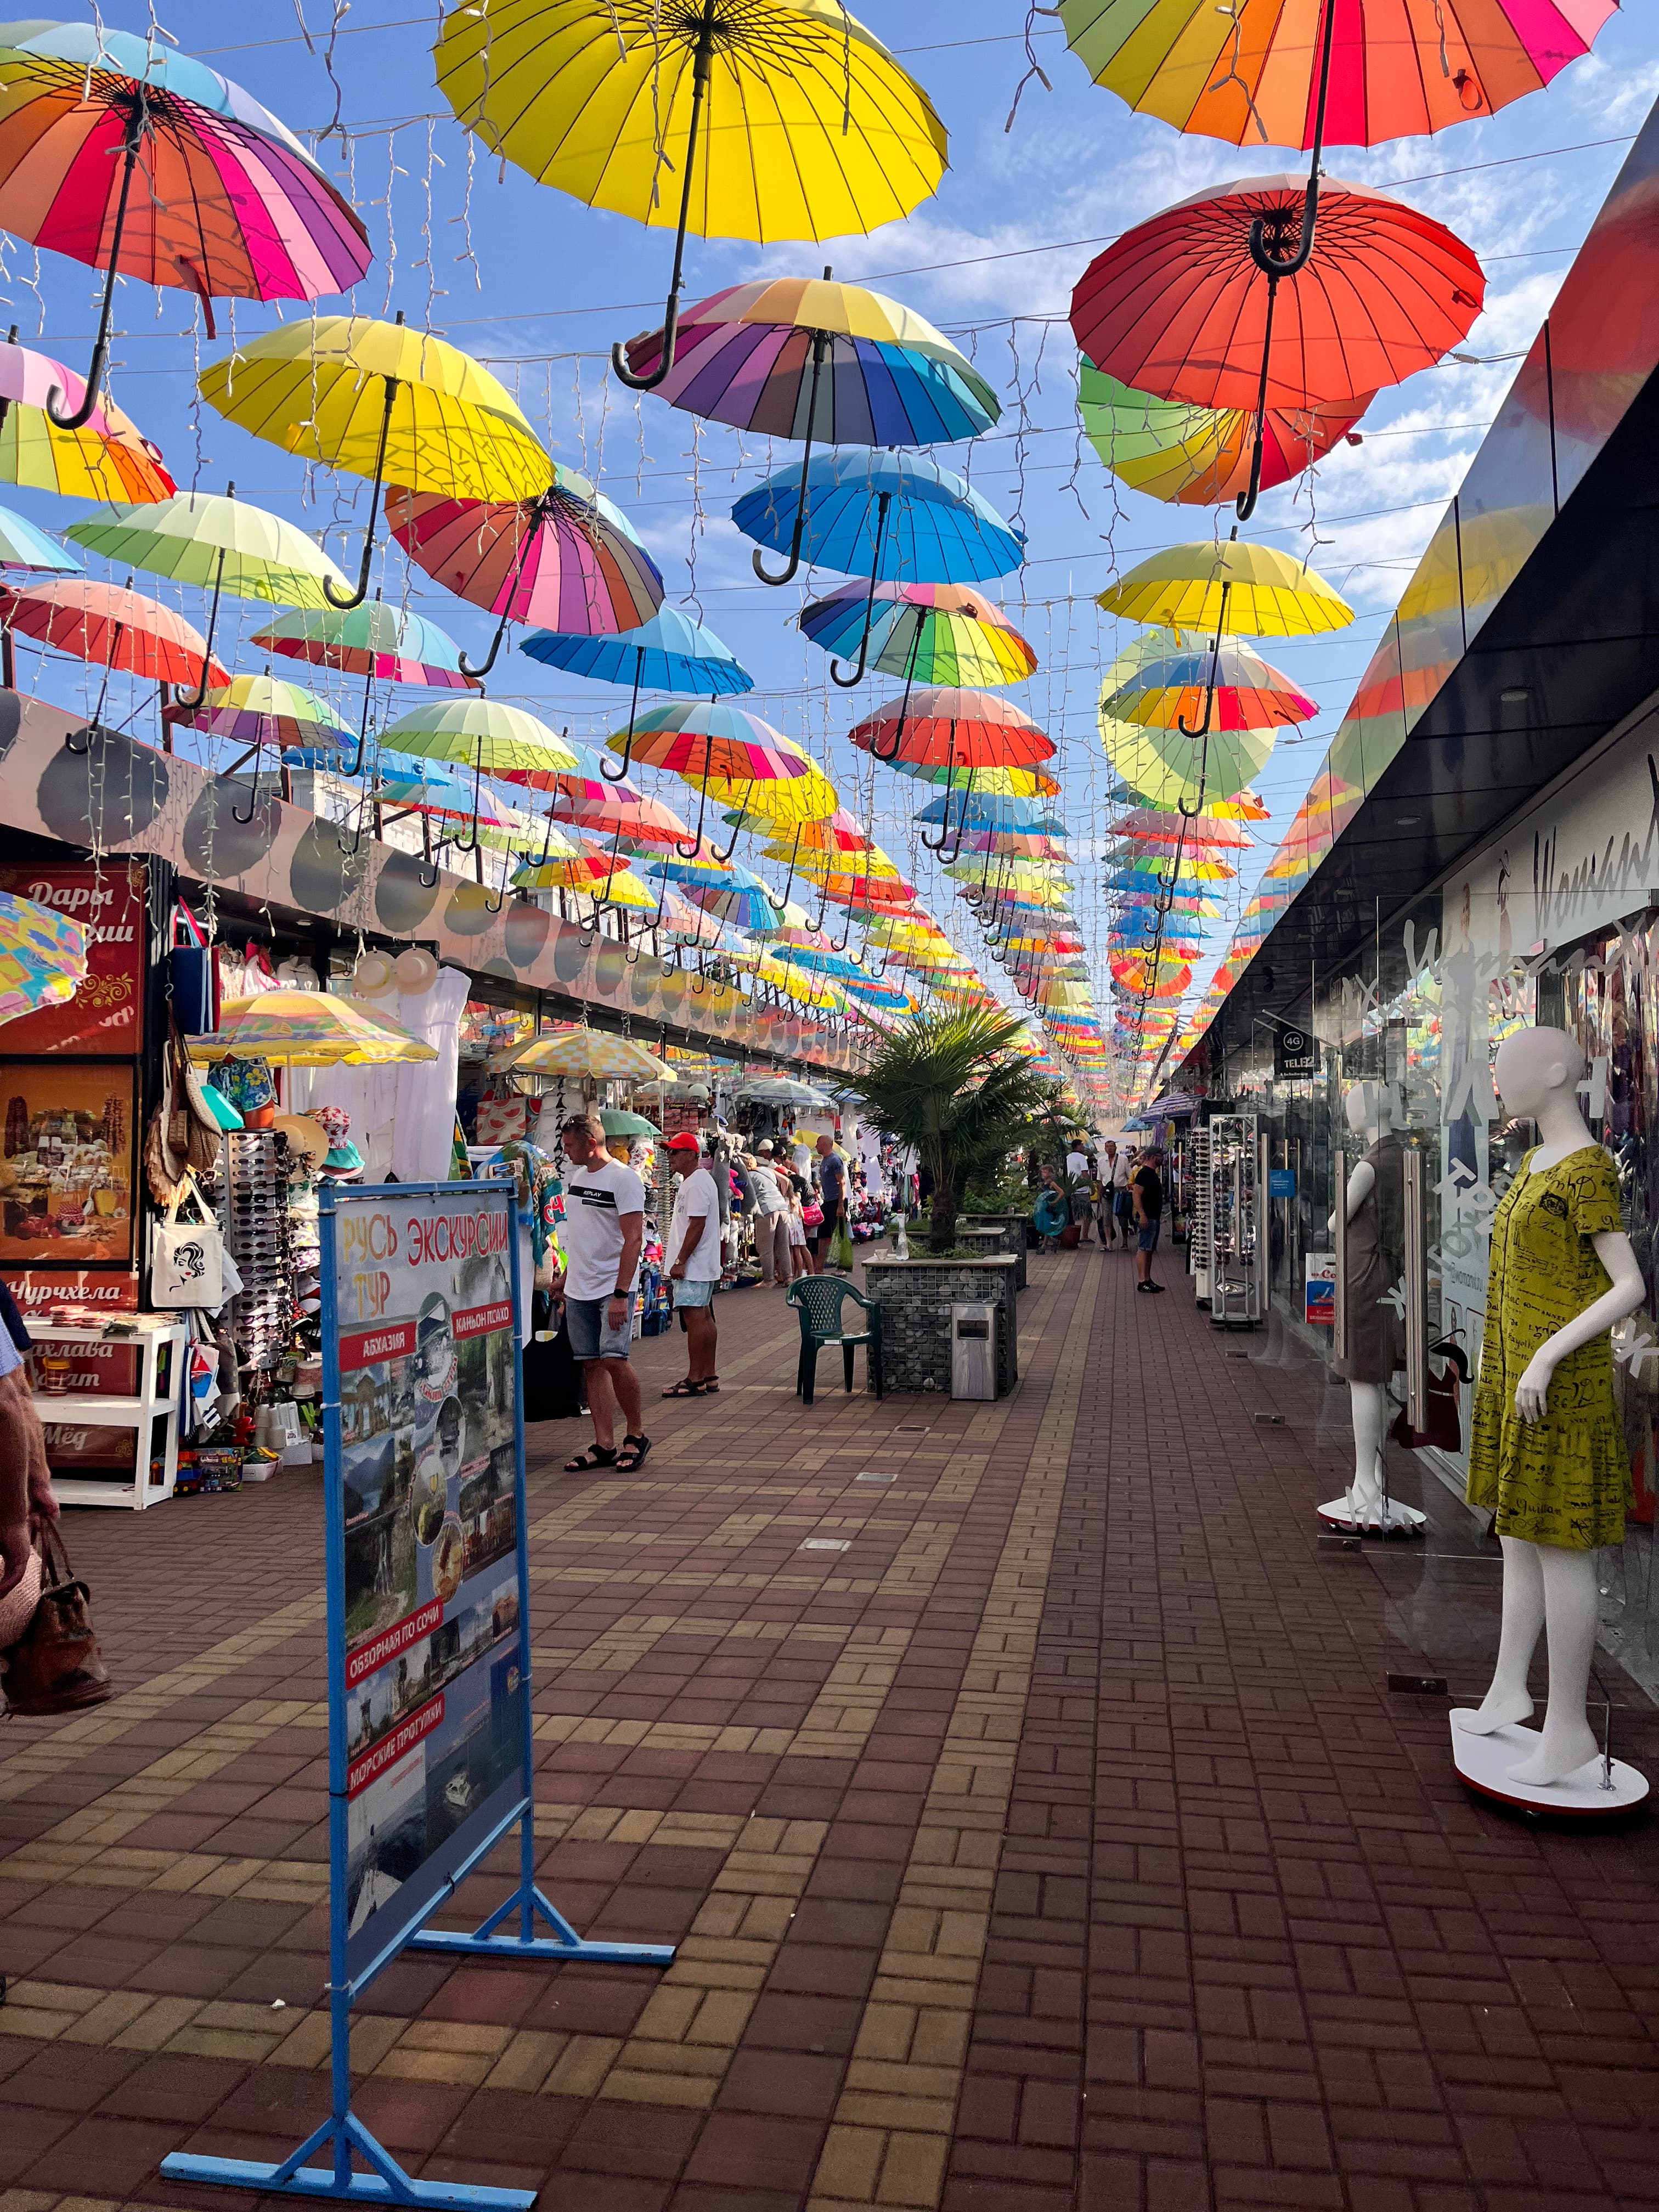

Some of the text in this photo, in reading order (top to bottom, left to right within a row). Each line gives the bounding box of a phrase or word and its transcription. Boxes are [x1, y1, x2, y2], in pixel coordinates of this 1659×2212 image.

[27, 882, 114, 912] Дары
[1286, 1037, 1300, 1045] 4G
[343, 1210, 509, 1266] РУСЬ ЭКСКУРСИИ
[7, 1280, 120, 1305] Чурчхела
[353, 1270, 391, 1319] ТУР
[455, 1306, 510, 1333] КАНЬОН ПСАХО
[25, 1342, 114, 1358] ахлава
[363, 1331, 405, 1358] АБХАЗИЯ
[43, 1426, 88, 1451] Мёд
[349, 1604, 439, 1678] ОБЗОРНАЯ ПО СОЧИ
[349, 1737, 396, 1791] МОРСКИЕ
